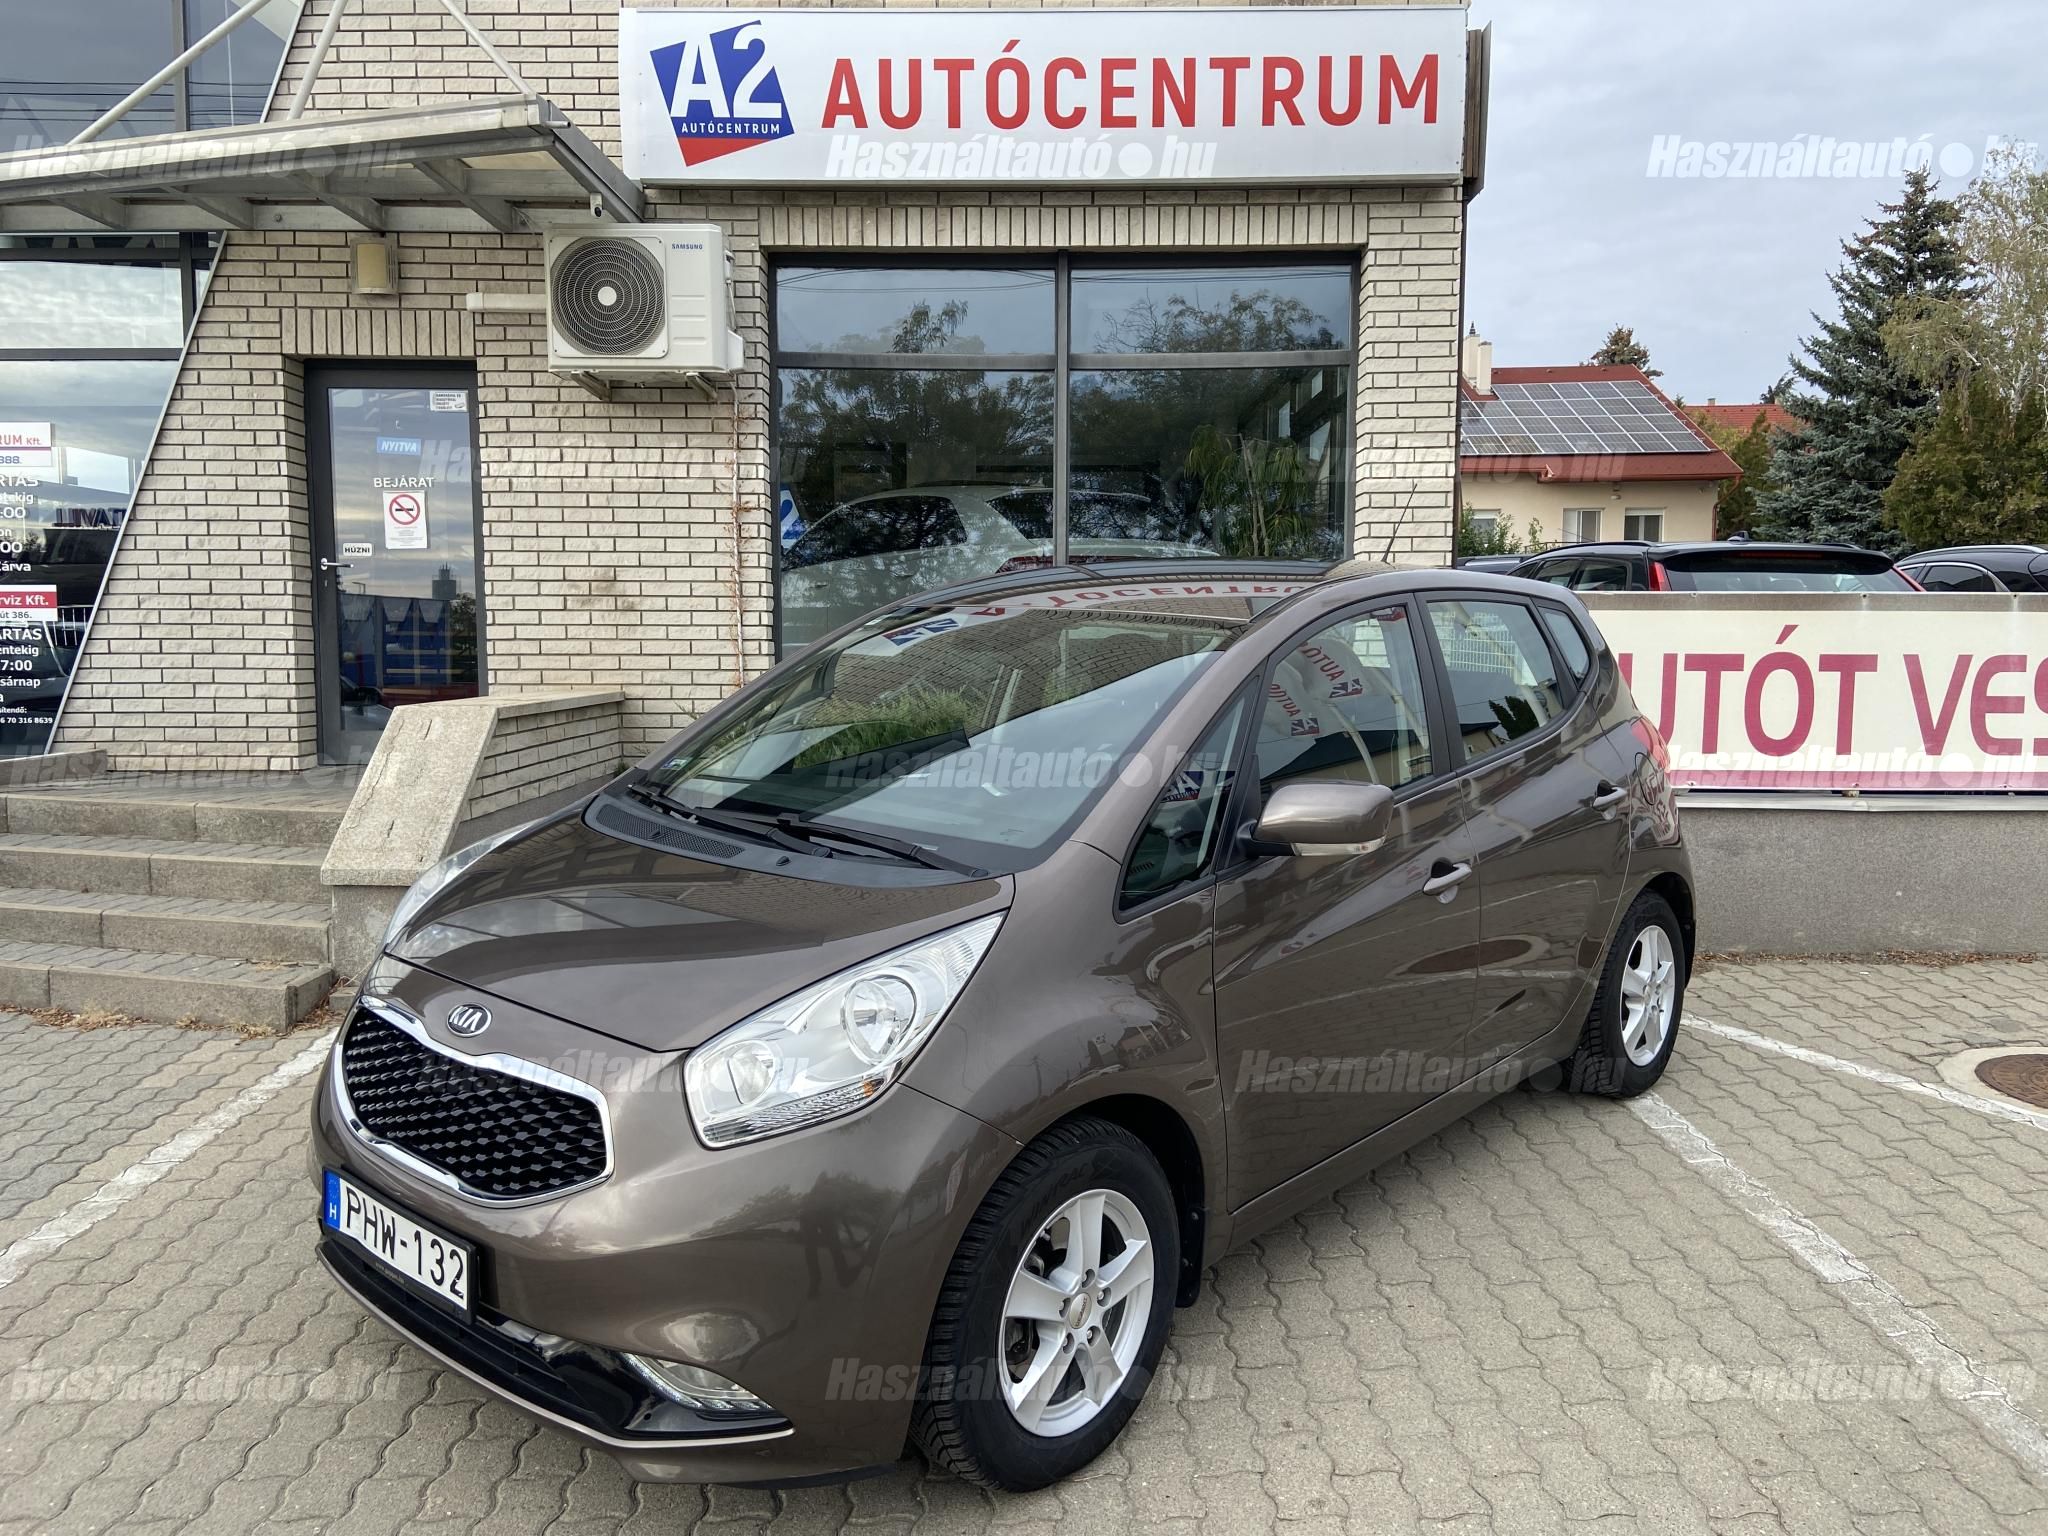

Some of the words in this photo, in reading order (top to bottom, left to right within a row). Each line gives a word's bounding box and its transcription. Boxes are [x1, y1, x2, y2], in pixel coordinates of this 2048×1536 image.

[671, 24, 782, 118] A2
[821, 39, 1440, 130] AUTÓCENTRUM
[681, 120, 780, 134] AUTÓCENTRUM
[381, 441, 418, 452] NYITVA
[373, 475, 434, 488] BEJÁRAT
[344, 545, 370, 553] HÚZNI
[25, 594, 49, 606] Kft.
[329, 1202, 337, 1220] H
[346, 1185, 465, 1300] PHW-132
